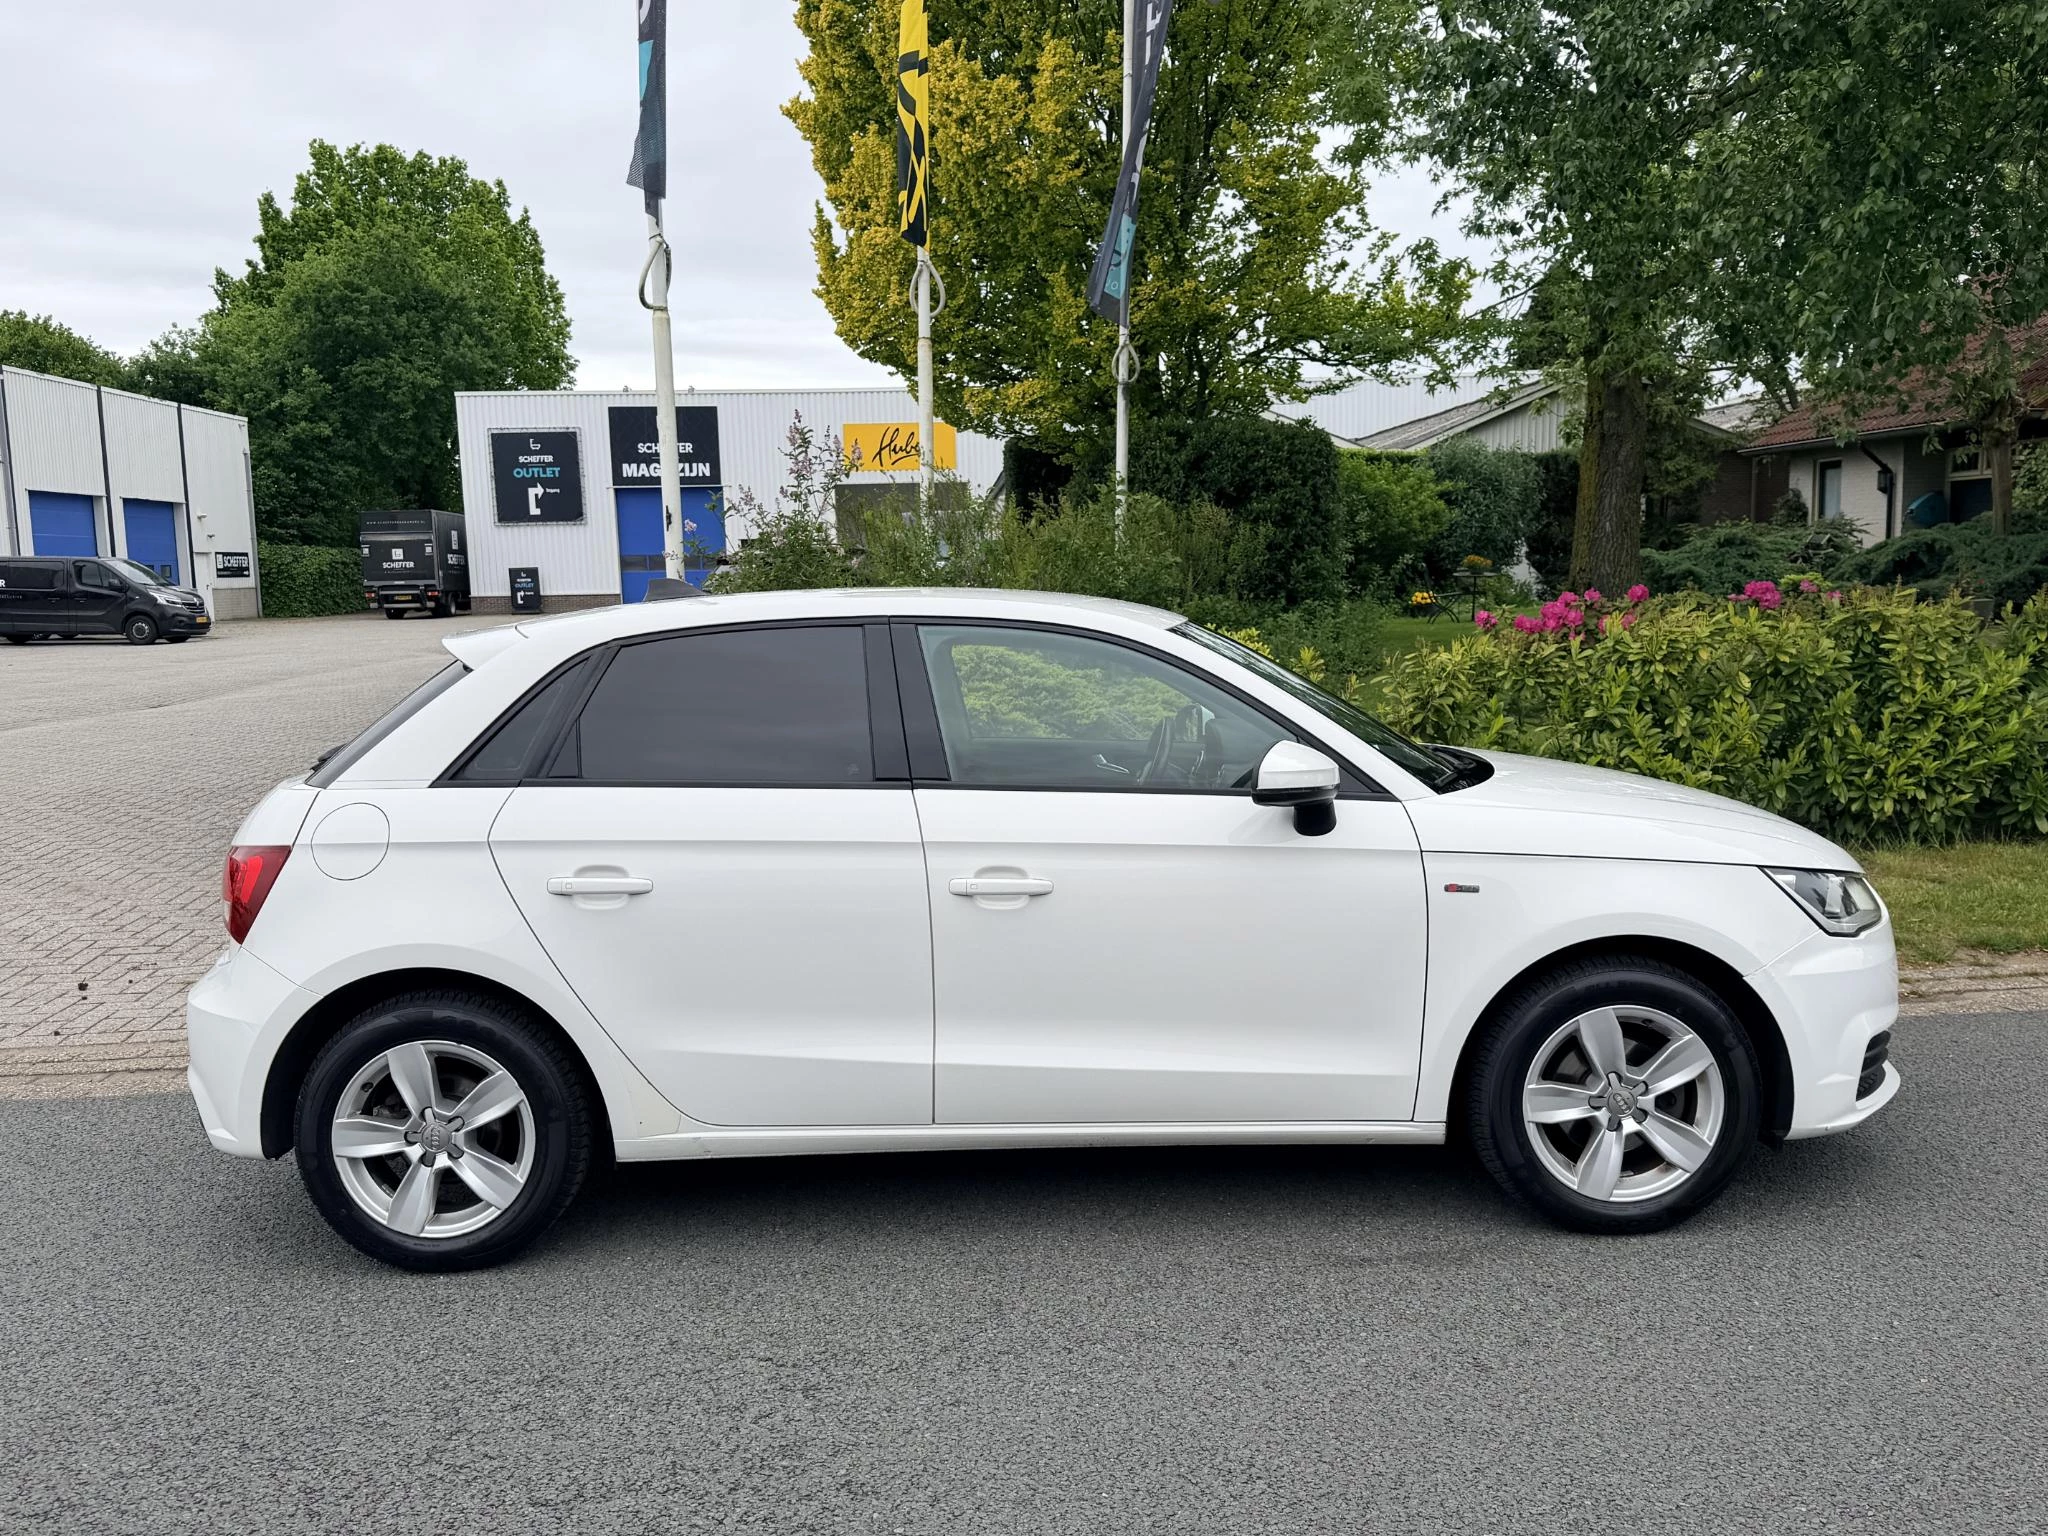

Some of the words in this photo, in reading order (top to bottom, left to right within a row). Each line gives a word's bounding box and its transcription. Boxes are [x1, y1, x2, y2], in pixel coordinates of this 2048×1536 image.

[637, 442, 694, 454] SCHER
[518, 454, 554, 463] SCHEFFER
[513, 467, 561, 478] OUTLET
[622, 462, 711, 478] MAGZIJN
[223, 555, 249, 568] SCHEFFER
[382, 561, 415, 569] SCHEFFER
